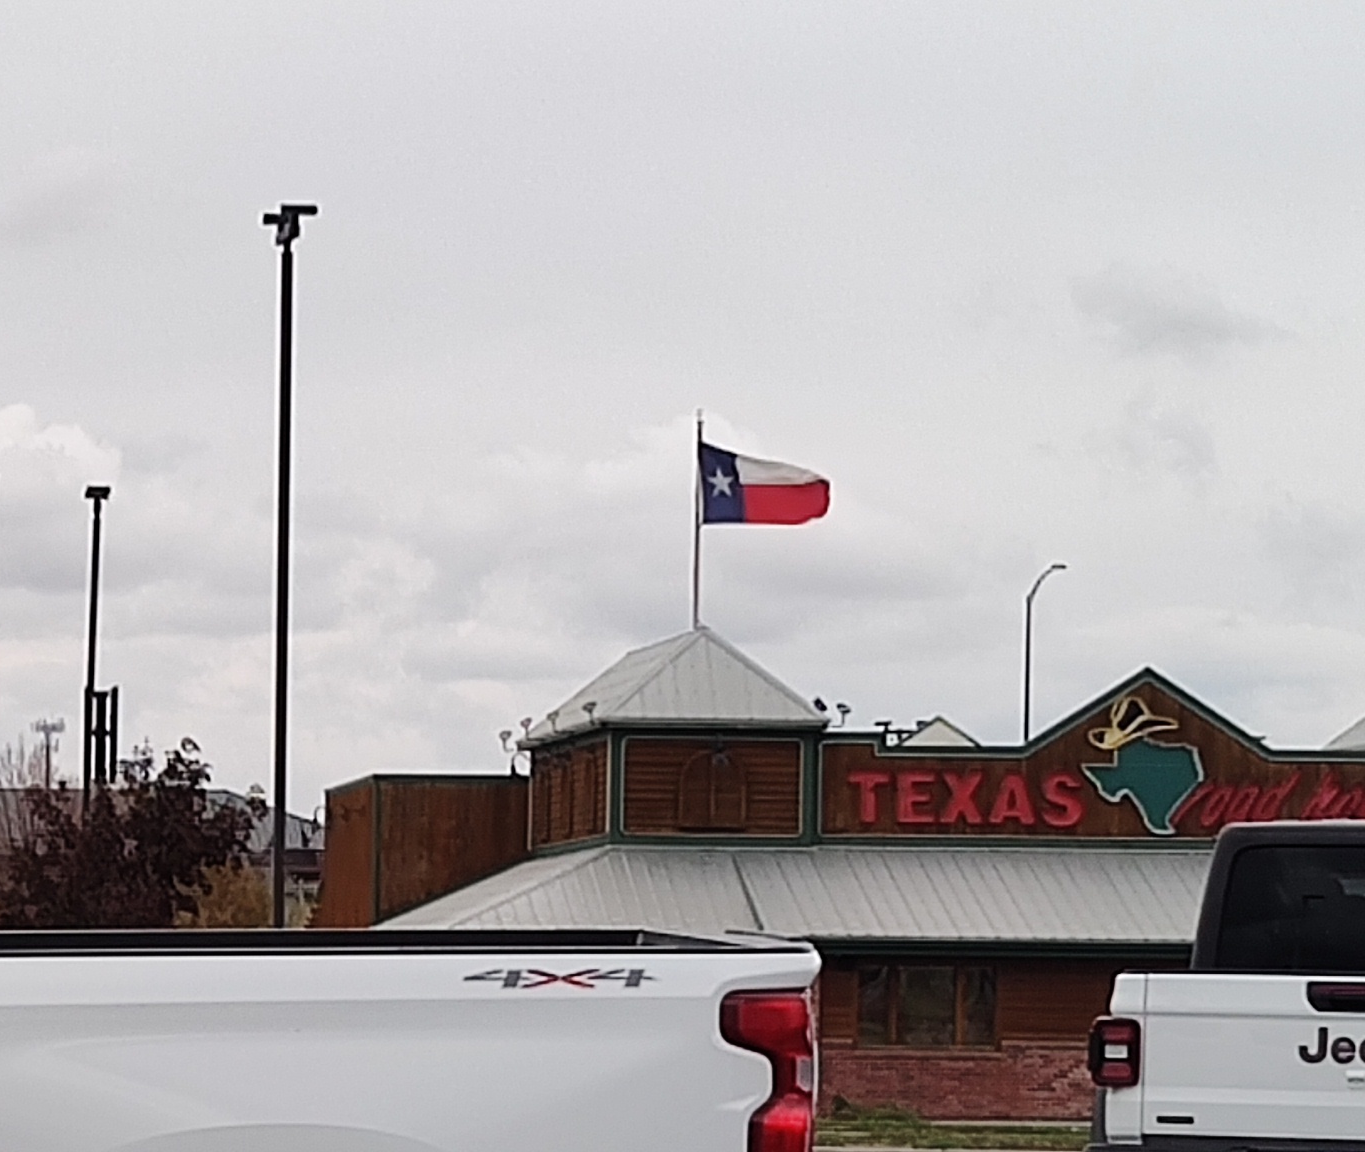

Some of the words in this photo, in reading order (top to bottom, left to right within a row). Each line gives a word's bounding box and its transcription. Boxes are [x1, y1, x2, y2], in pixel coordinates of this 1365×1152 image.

[847, 771, 1087, 827] TEXAS
[1171, 771, 1302, 827] road
[1298, 1026, 1365, 1064] Je
